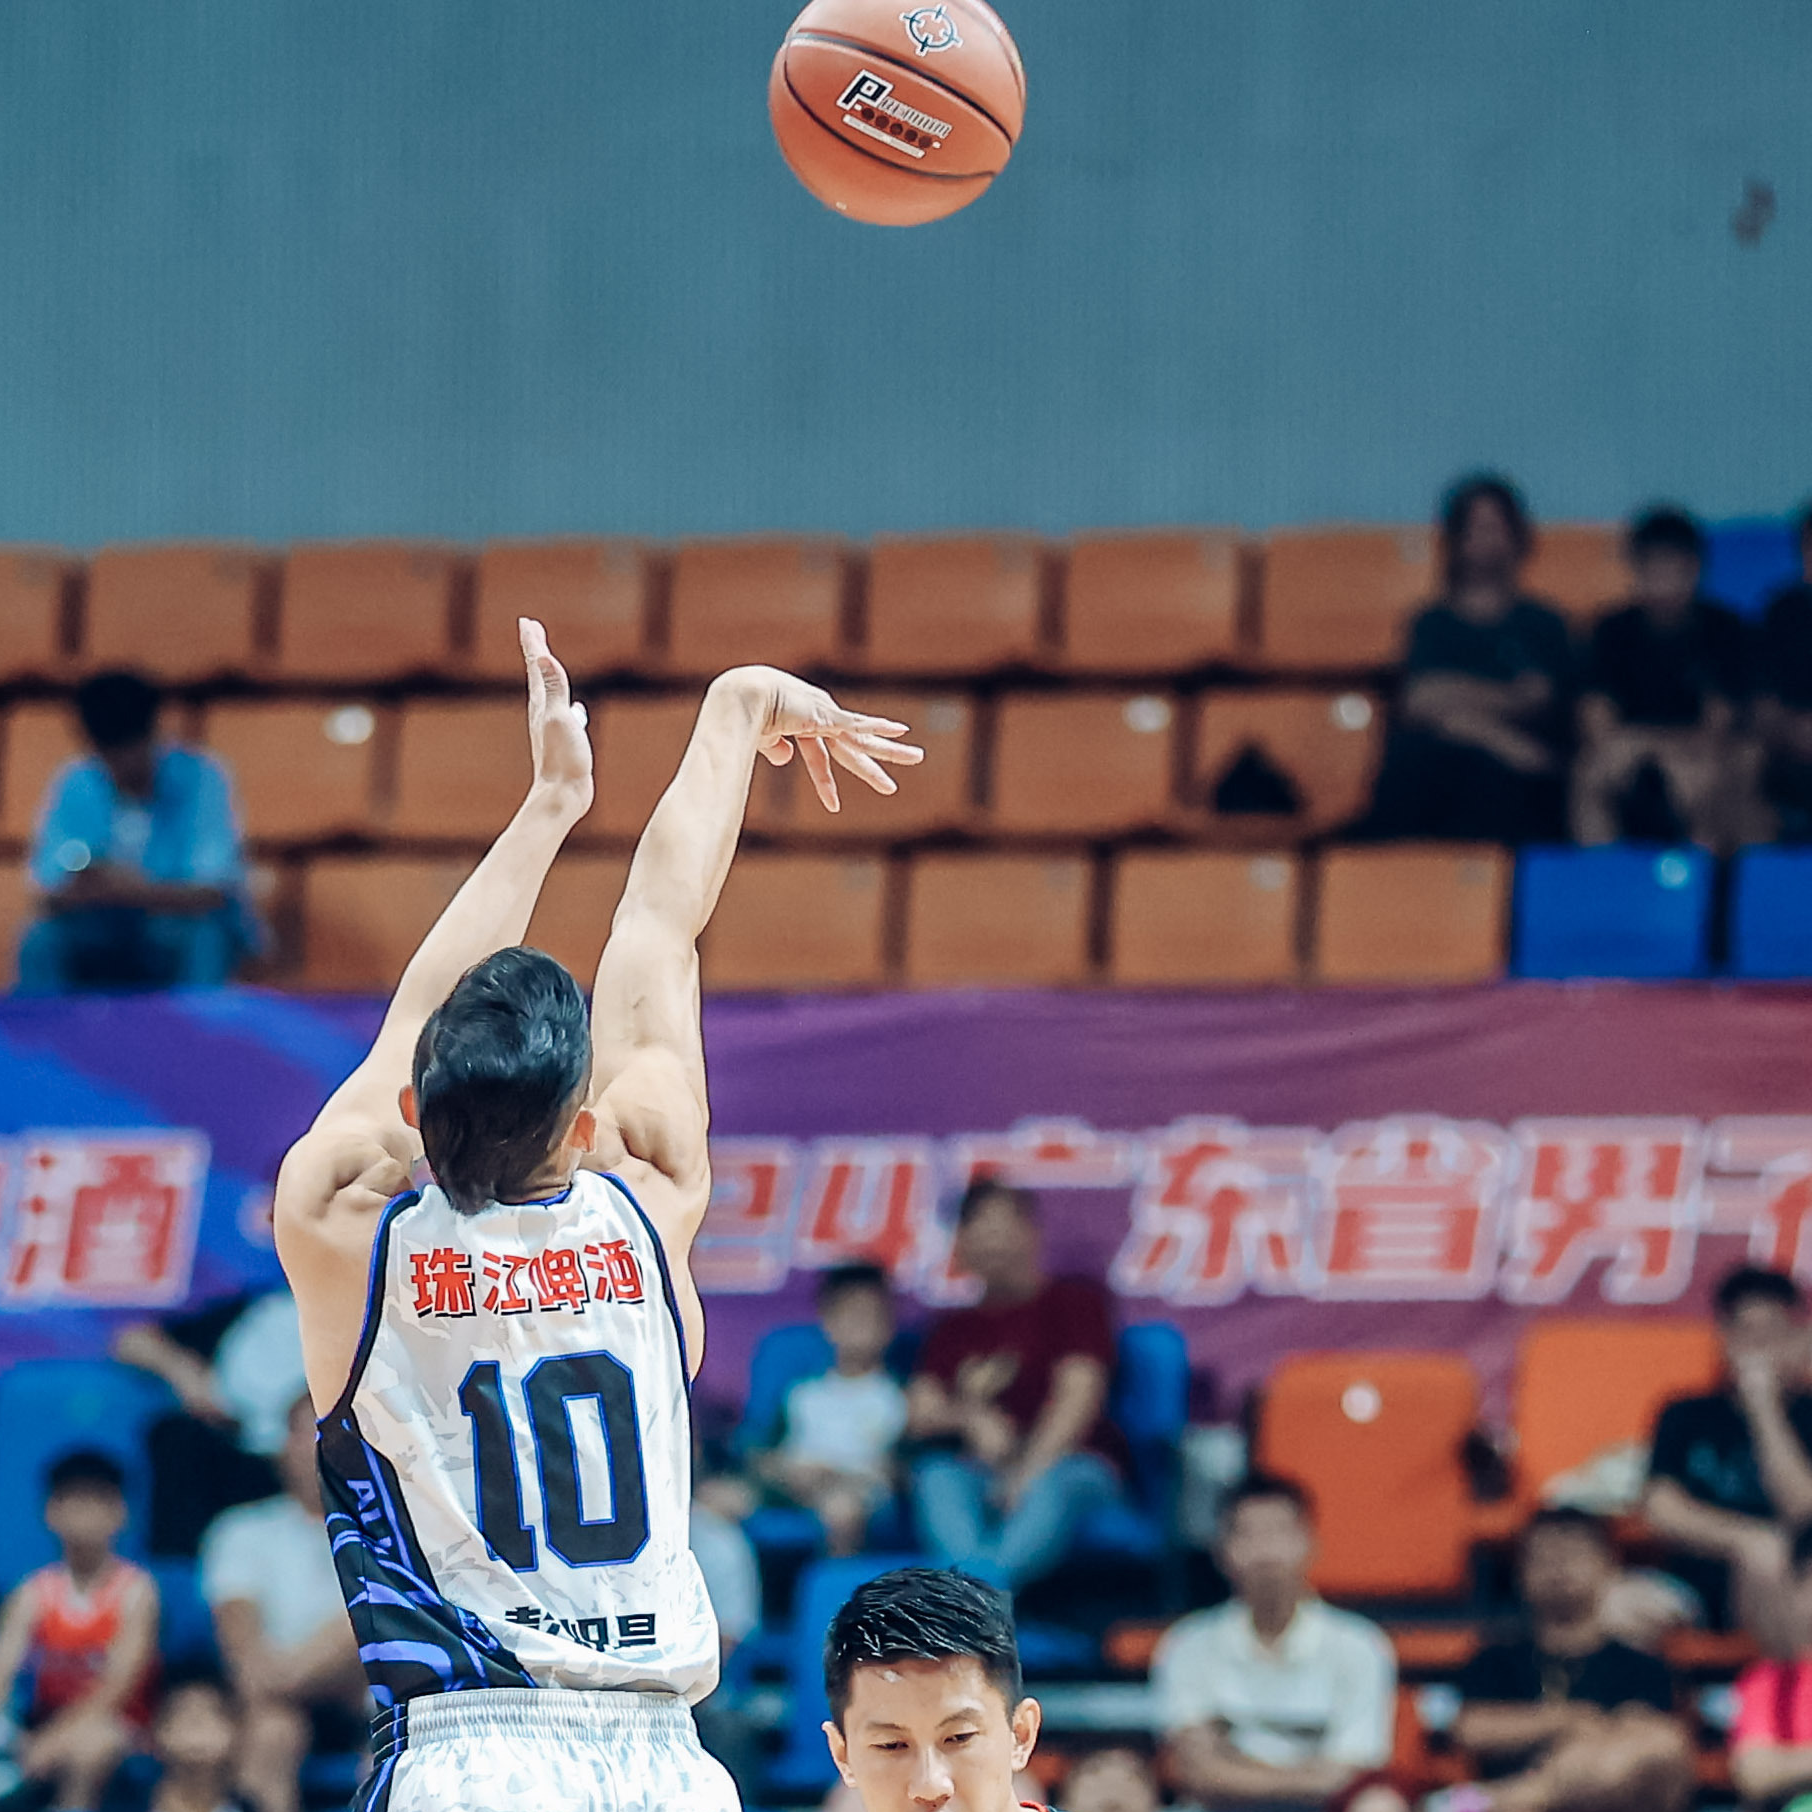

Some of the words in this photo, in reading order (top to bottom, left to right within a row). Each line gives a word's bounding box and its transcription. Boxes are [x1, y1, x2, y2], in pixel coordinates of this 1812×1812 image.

[410, 1239, 644, 1317] 珠江啤酒
[458, 1350, 651, 1571] 10
